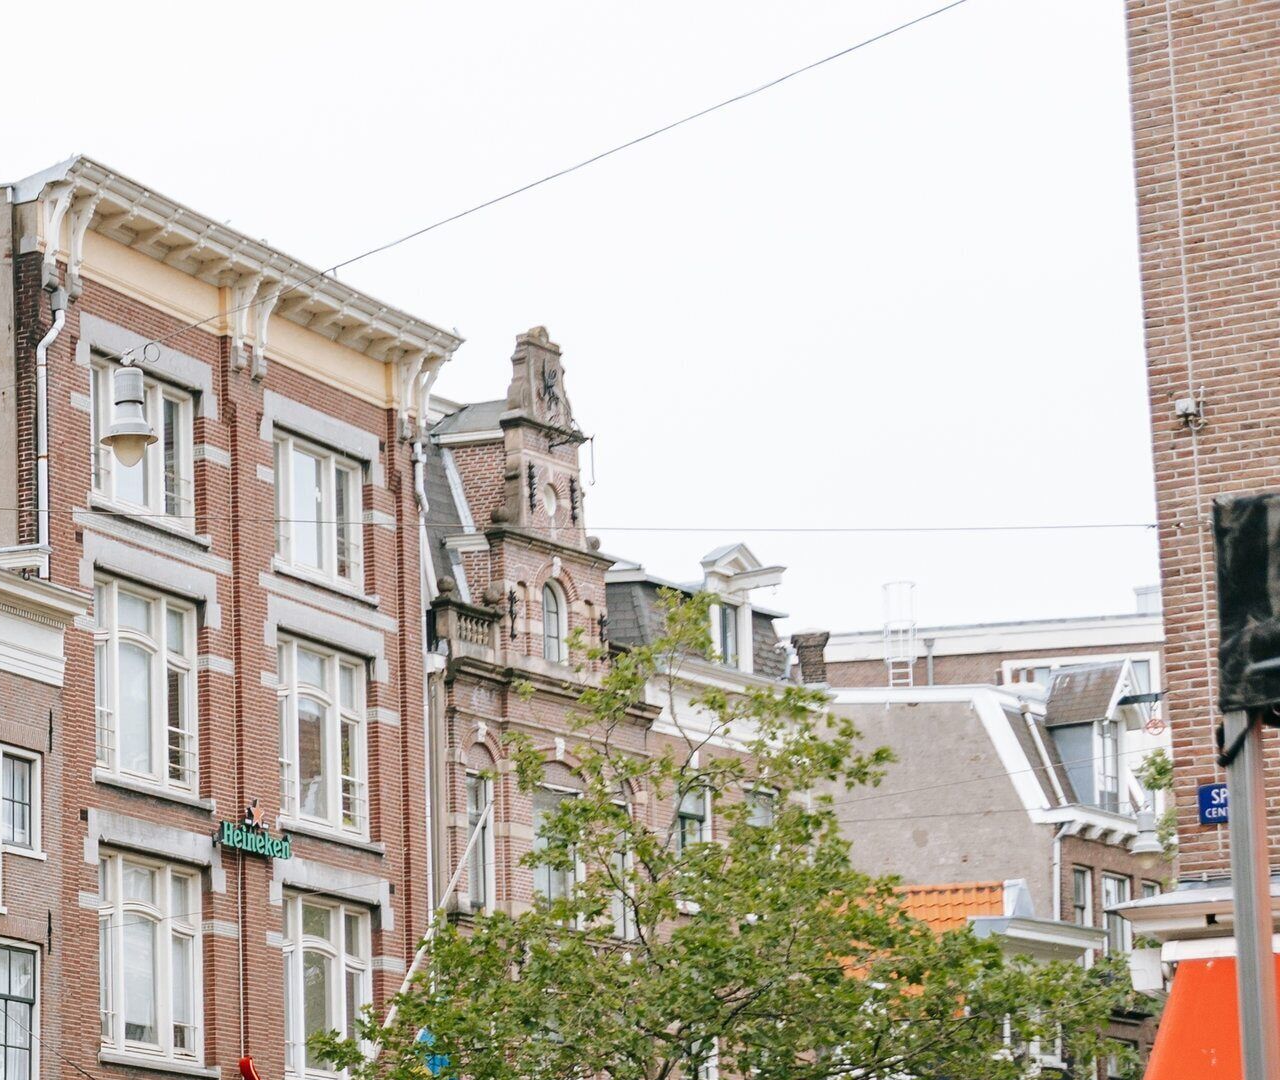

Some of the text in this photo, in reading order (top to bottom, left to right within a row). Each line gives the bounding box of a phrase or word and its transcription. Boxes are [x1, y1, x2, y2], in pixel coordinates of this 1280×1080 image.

[1211, 788, 1229, 804] SP
[1205, 807, 1229, 818] CEN
[220, 820, 292, 859] Heineken
